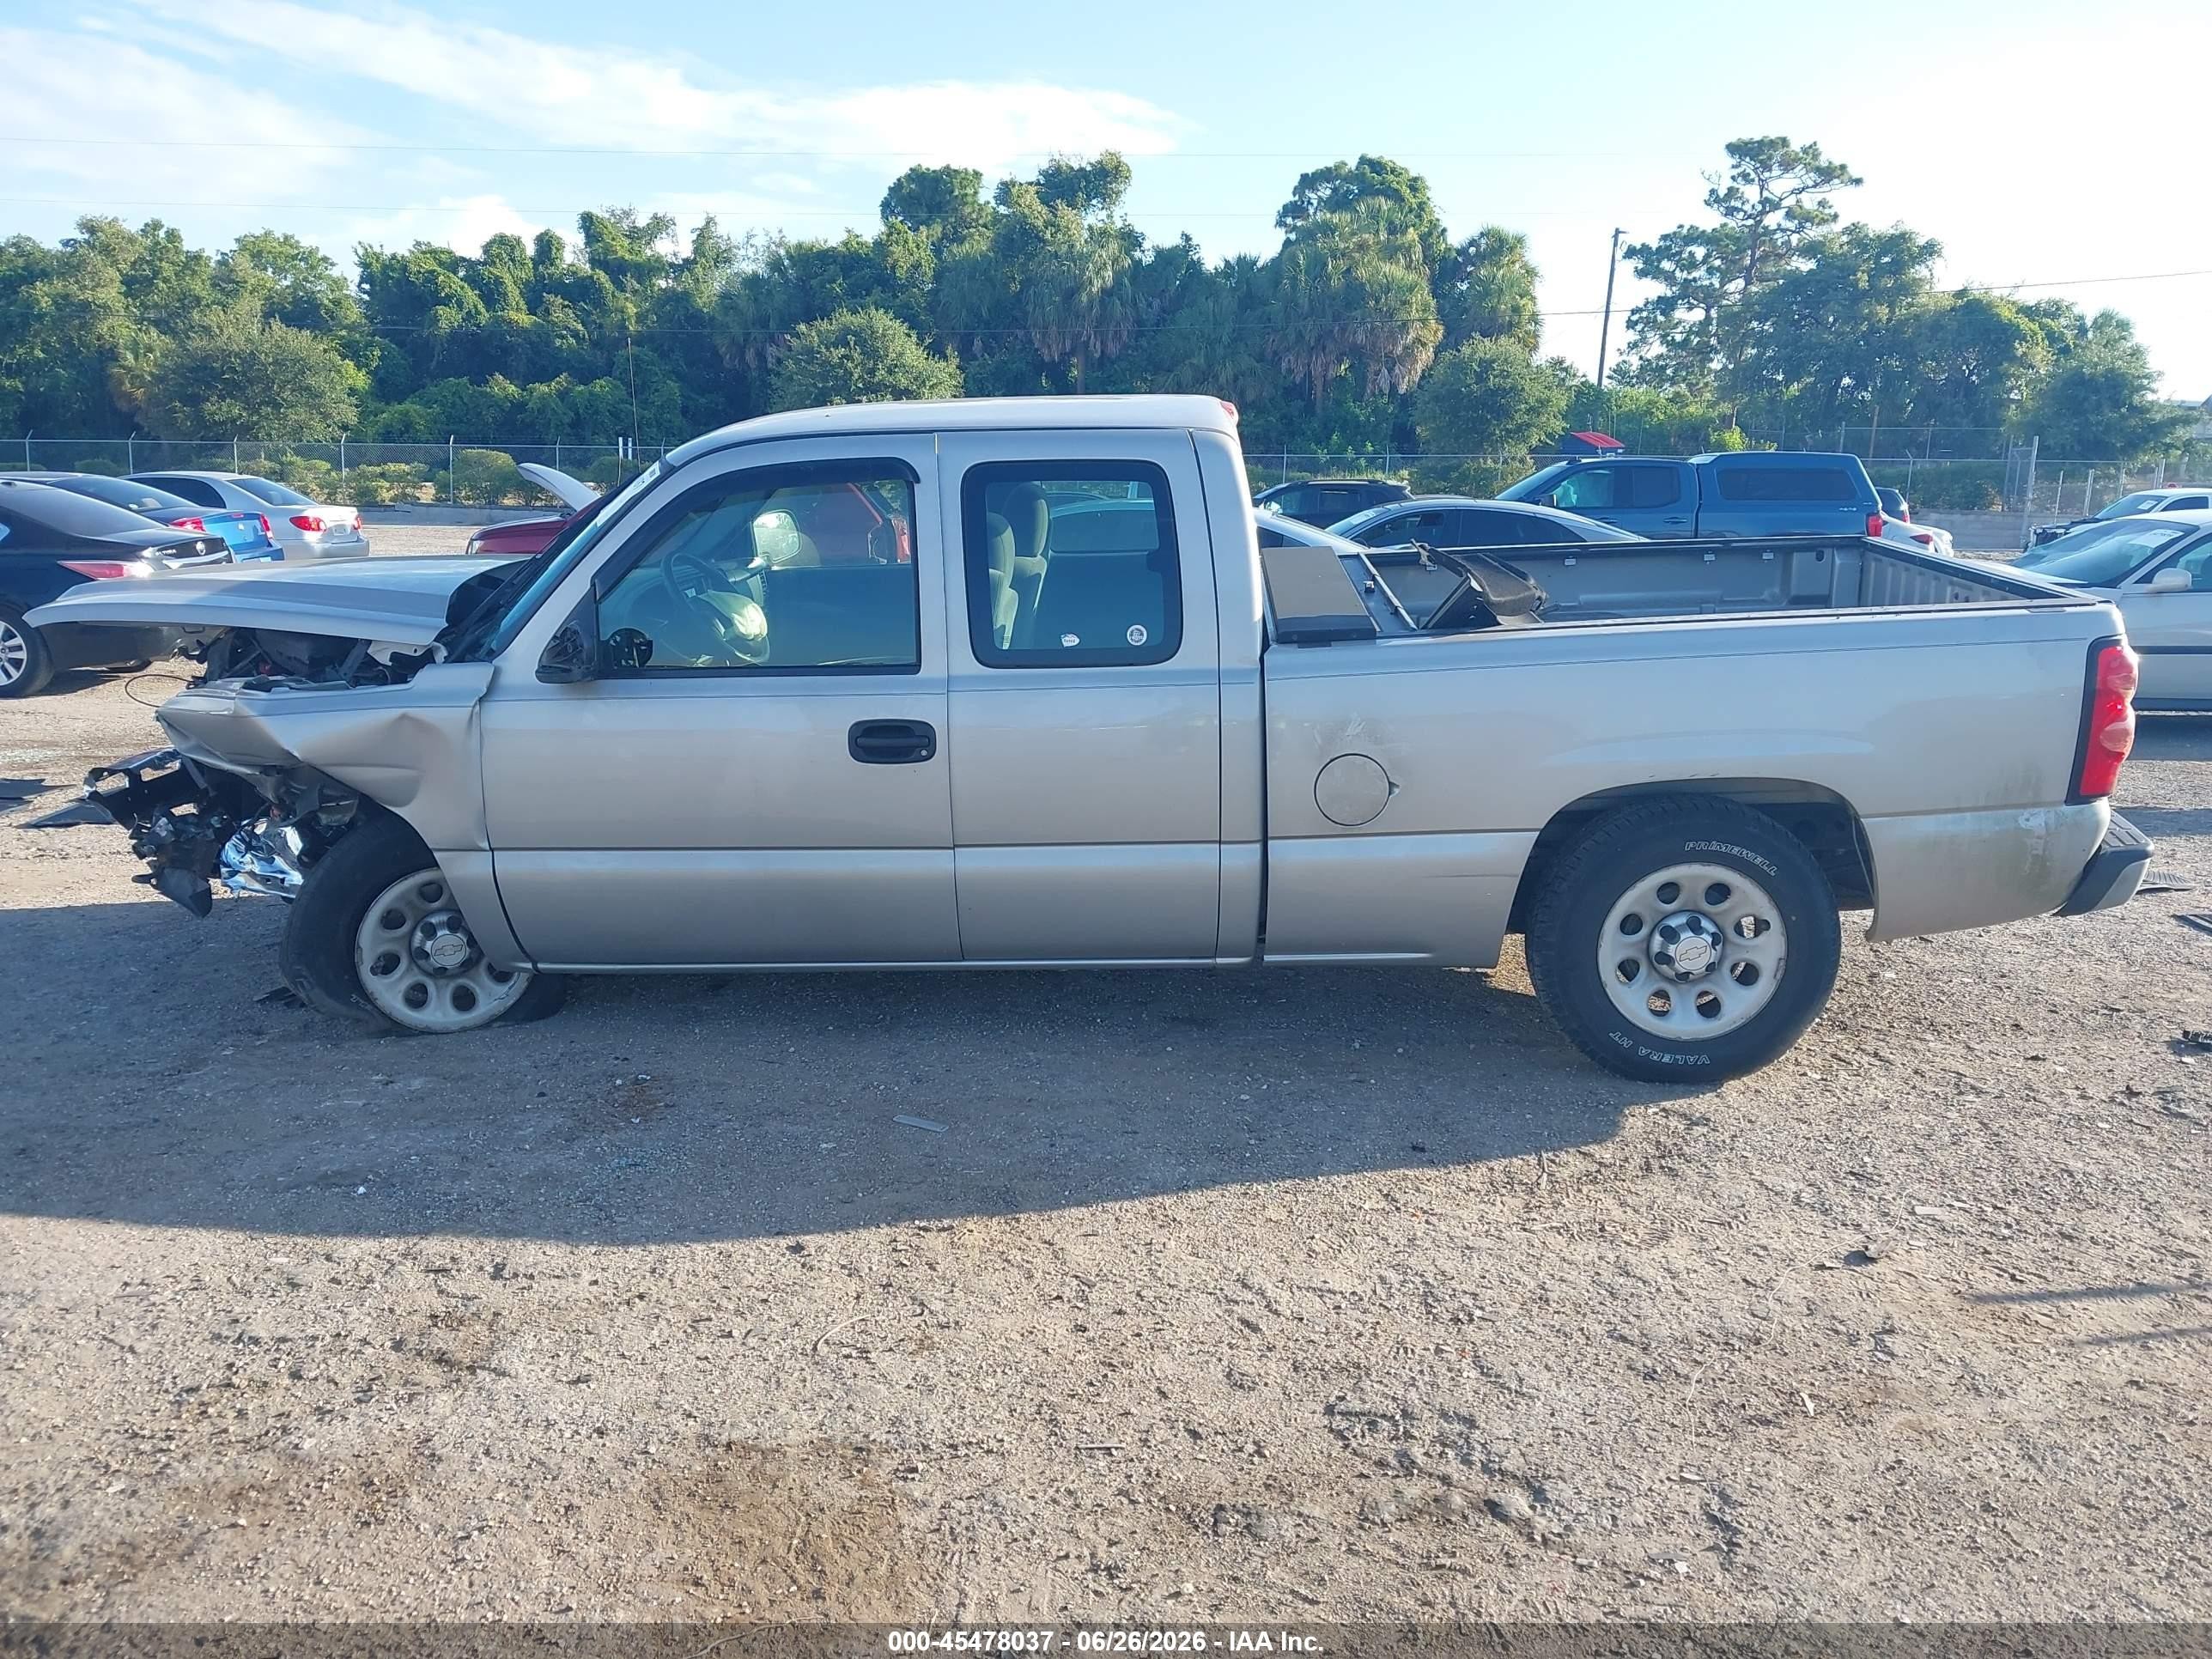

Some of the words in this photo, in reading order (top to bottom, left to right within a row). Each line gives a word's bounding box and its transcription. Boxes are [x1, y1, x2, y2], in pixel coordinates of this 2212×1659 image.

[1685, 841, 1778, 877] PRIMEWELL
[1608, 1031, 1633, 1048] HT
[1638, 1046, 1710, 1065] VALERA
